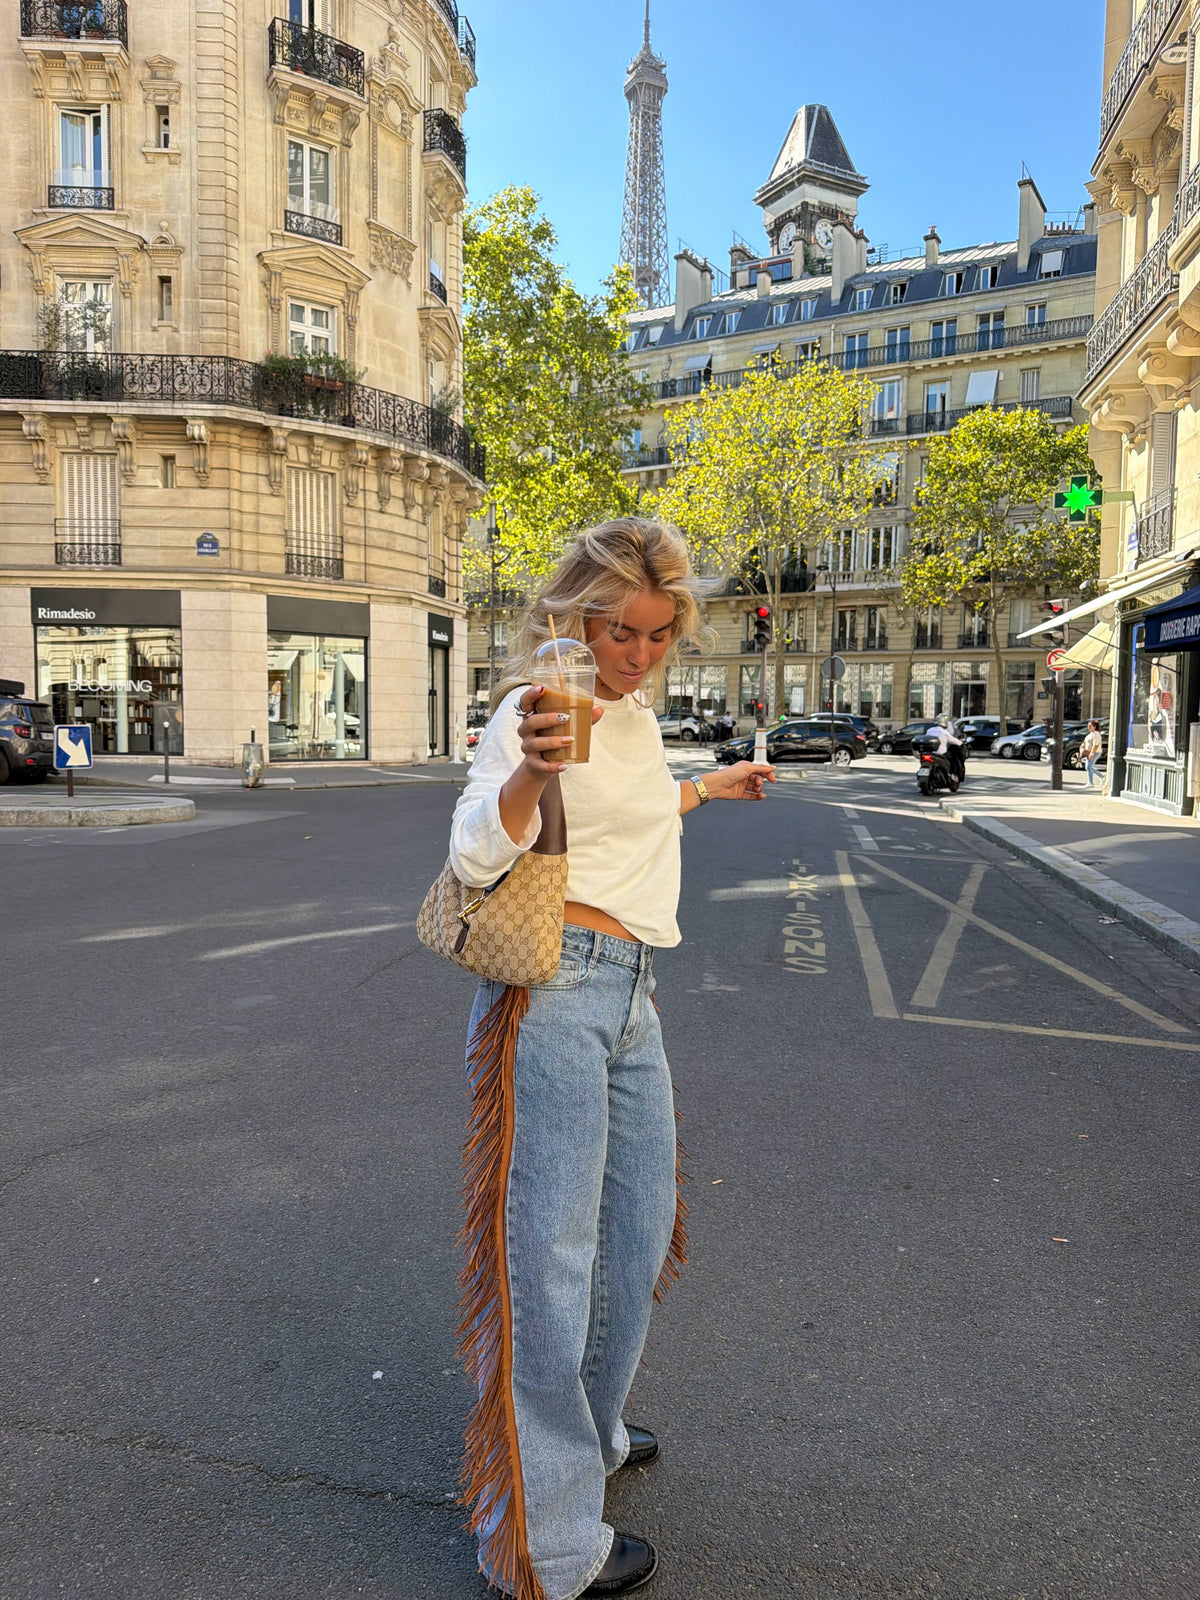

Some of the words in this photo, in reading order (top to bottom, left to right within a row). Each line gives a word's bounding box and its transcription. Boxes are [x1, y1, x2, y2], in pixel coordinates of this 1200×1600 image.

[38, 607, 96, 619] Rimadesio
[68, 679, 152, 692] BECOMING
[782, 858, 828, 974] LIVRAISONS
